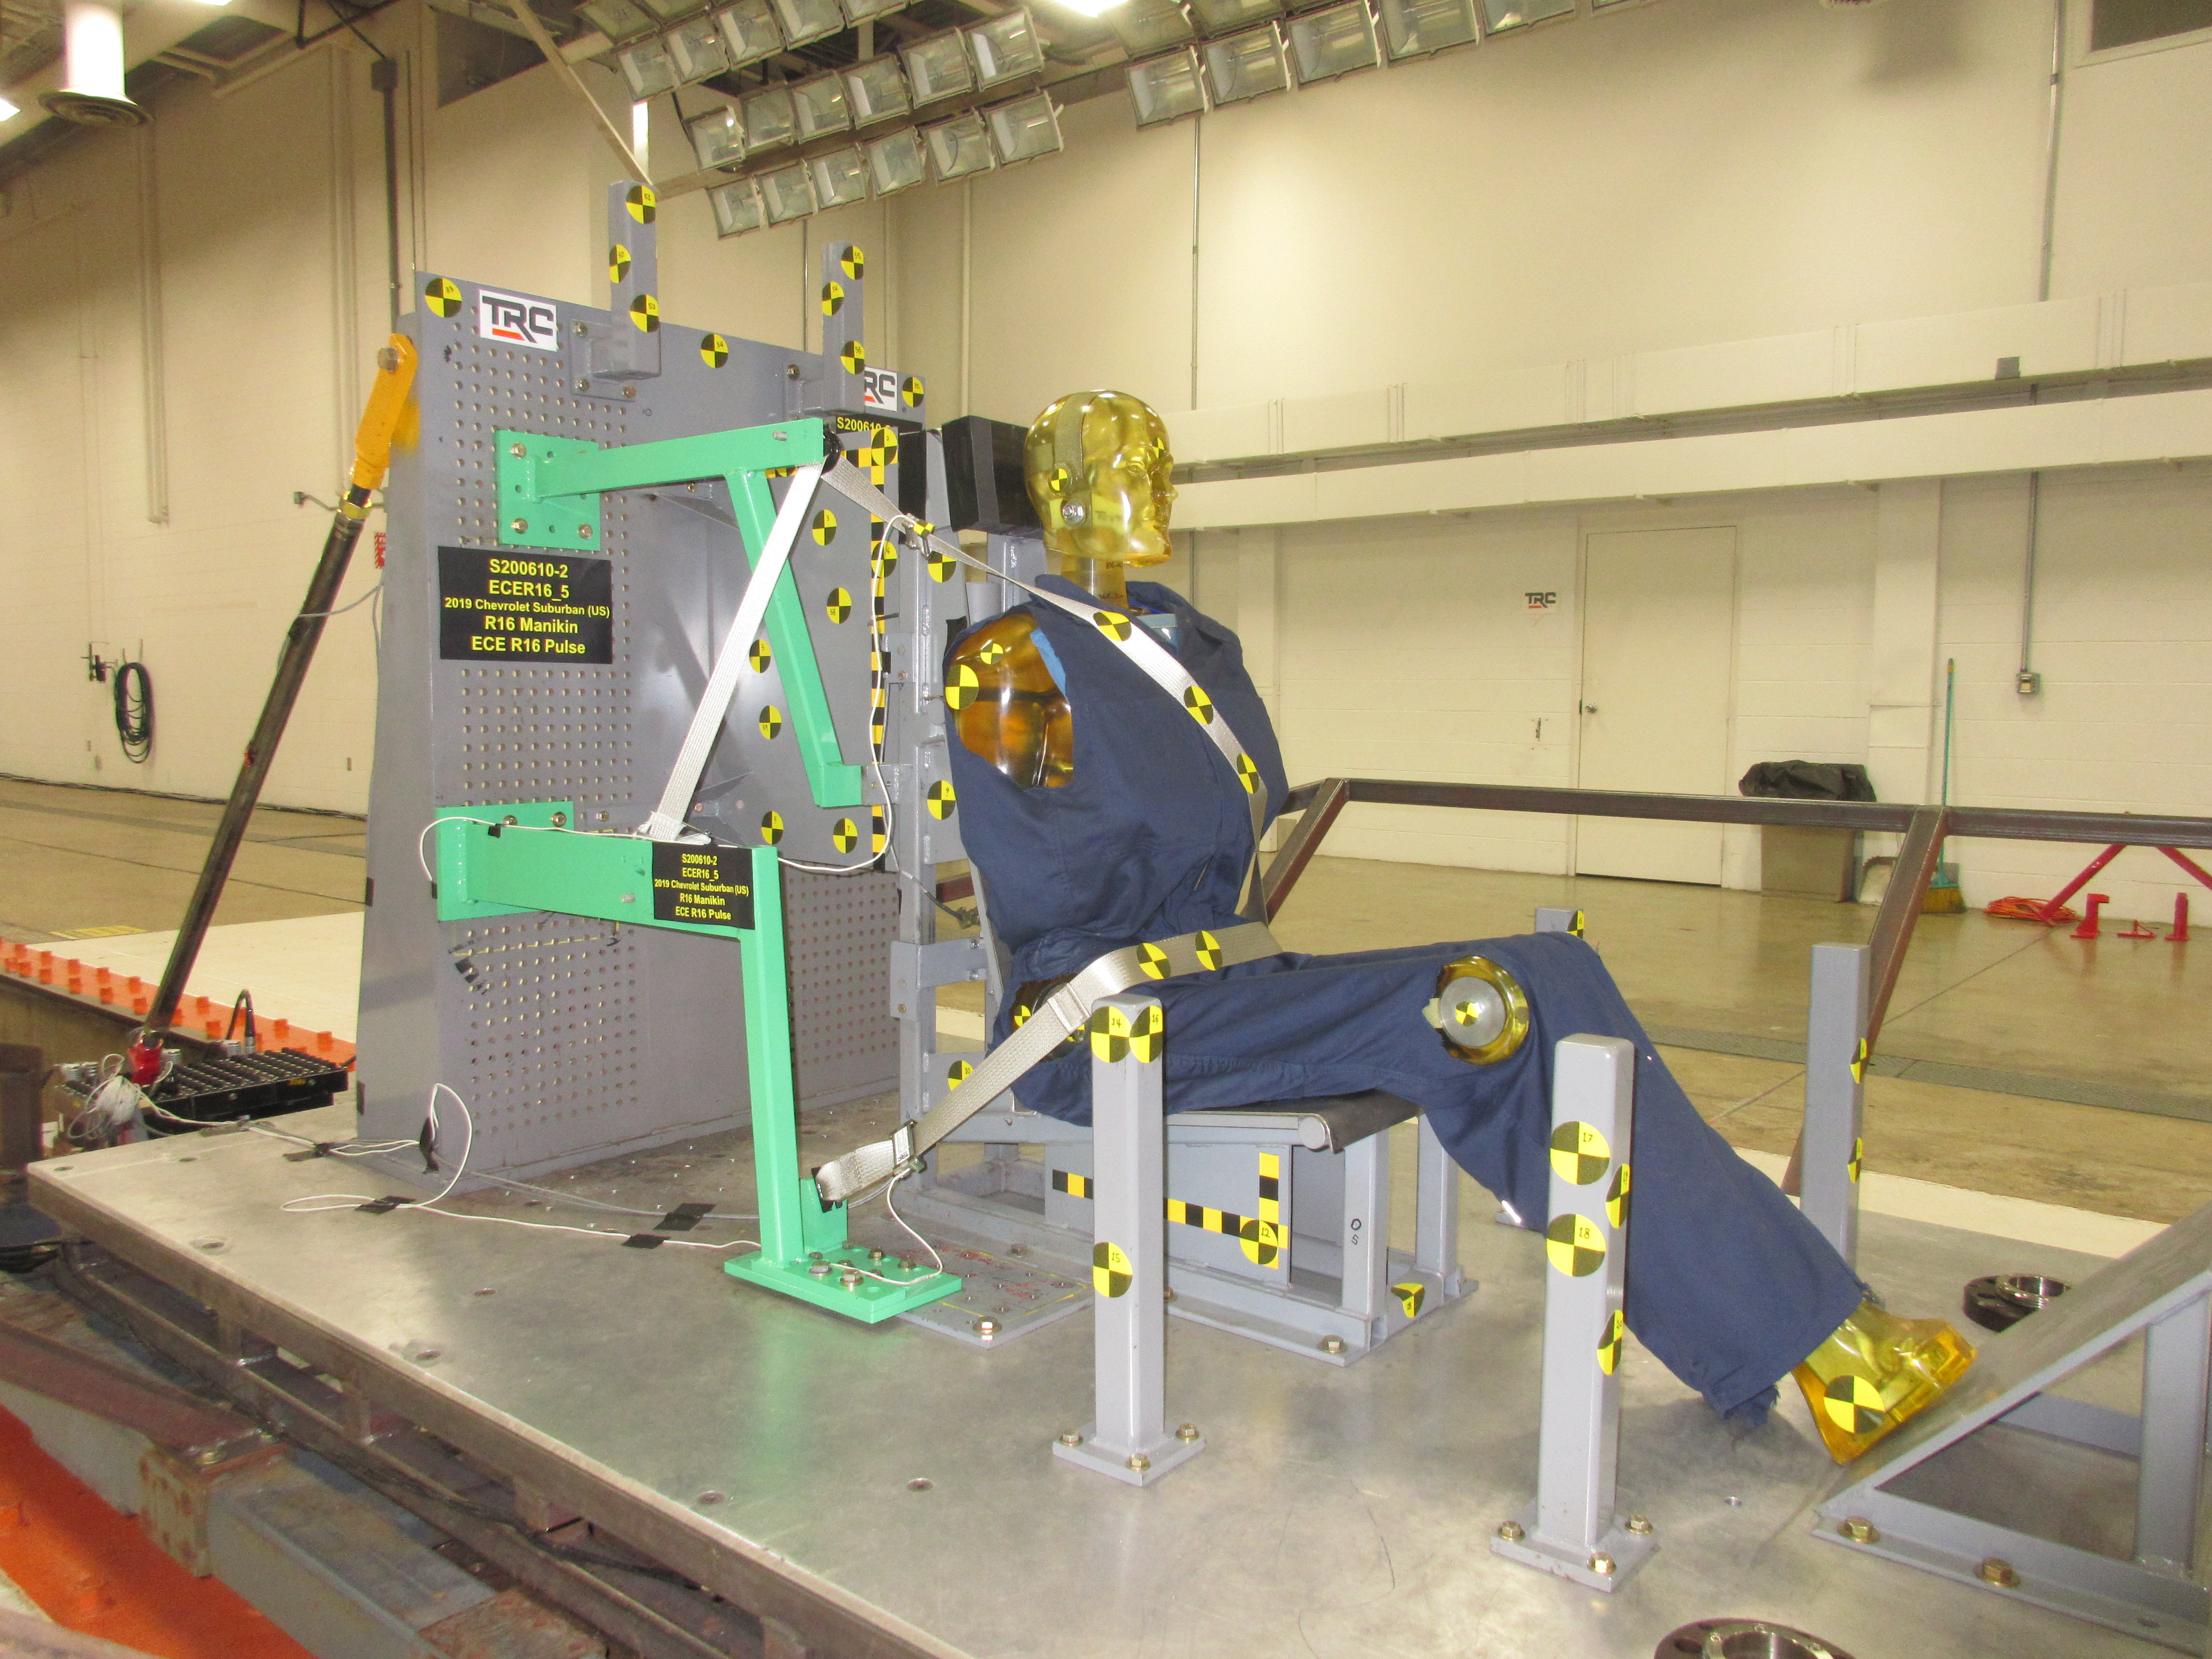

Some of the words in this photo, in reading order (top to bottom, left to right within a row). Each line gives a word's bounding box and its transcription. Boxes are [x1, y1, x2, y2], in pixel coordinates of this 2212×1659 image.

[482, 295, 554, 344] TRC
[864, 371, 896, 404] RC
[489, 558, 569, 578] S200610-2
[489, 579, 570, 601] ECER16_5
[1525, 592, 1556, 608] TRC
[445, 597, 473, 609] 2019
[475, 599, 530, 613] Chevrolet
[533, 602, 585, 615] Suburban
[588, 605, 611, 618] (US)
[485, 615, 516, 631] R16
[520, 617, 578, 634] Manikin
[471, 636, 506, 652] ECE
[511, 637, 541, 653] R16
[545, 639, 586, 654] Pulse
[946, 787, 950, 796] 9
[682, 854, 718, 866] S200610-2
[682, 867, 719, 882] ECER16_5
[654, 879, 670, 888] 2019
[671, 880, 699, 890] Chevrolet
[701, 882, 734, 893] Suburban
[735, 885, 749, 897] (US)
[680, 893, 692, 903] R16
[694, 894, 725, 906] Manikin
[675, 906, 690, 917] ECE
[691, 908, 707, 918] R16
[709, 909, 732, 920] Pulse
[1111, 1018, 1122, 1028] 14
[1152, 1014, 1159, 1024] 16
[1583, 1132, 1593, 1142] 17
[1261, 1227, 1271, 1238] 12
[1578, 1226, 1590, 1239] 18
[1112, 1252, 1120, 1262] 15
